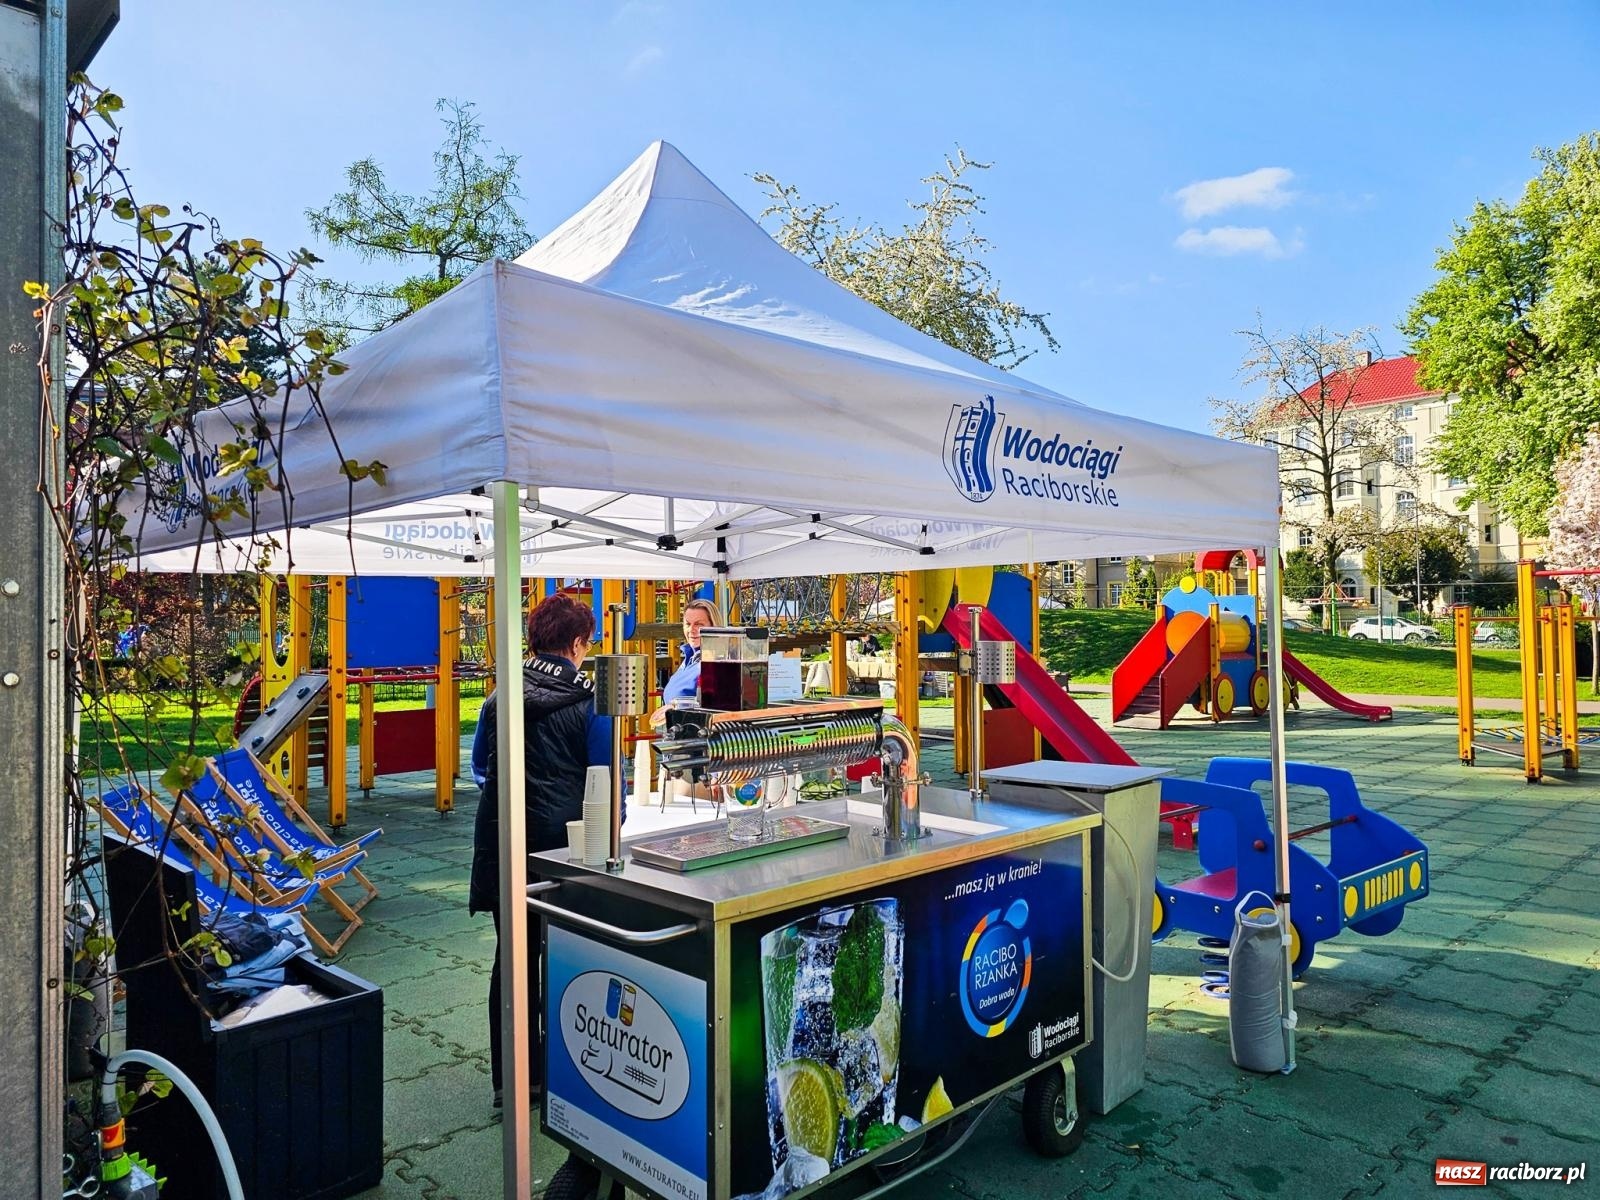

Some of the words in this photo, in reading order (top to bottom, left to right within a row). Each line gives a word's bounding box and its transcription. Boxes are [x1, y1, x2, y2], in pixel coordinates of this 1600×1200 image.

[1003, 425, 1123, 480] Wodociągi
[1002, 467, 1119, 507] Raciborskie
[523, 657, 563, 677] OVING
[984, 873, 995, 893] ją
[997, 875, 1007, 886] w
[1008, 859, 1042, 881] kranie!
[974, 943, 1017, 971] RACIBO
[975, 963, 1018, 990] RZANKA
[979, 995, 998, 1010] Dobra
[998, 987, 1015, 1001] woda
[574, 1003, 673, 1073] Saturator
[1044, 1012, 1079, 1038] Wodociągi
[1044, 1026, 1080, 1050] Raciborskie
[622, 1149, 700, 1200] WWW.SATURATOR.EU
